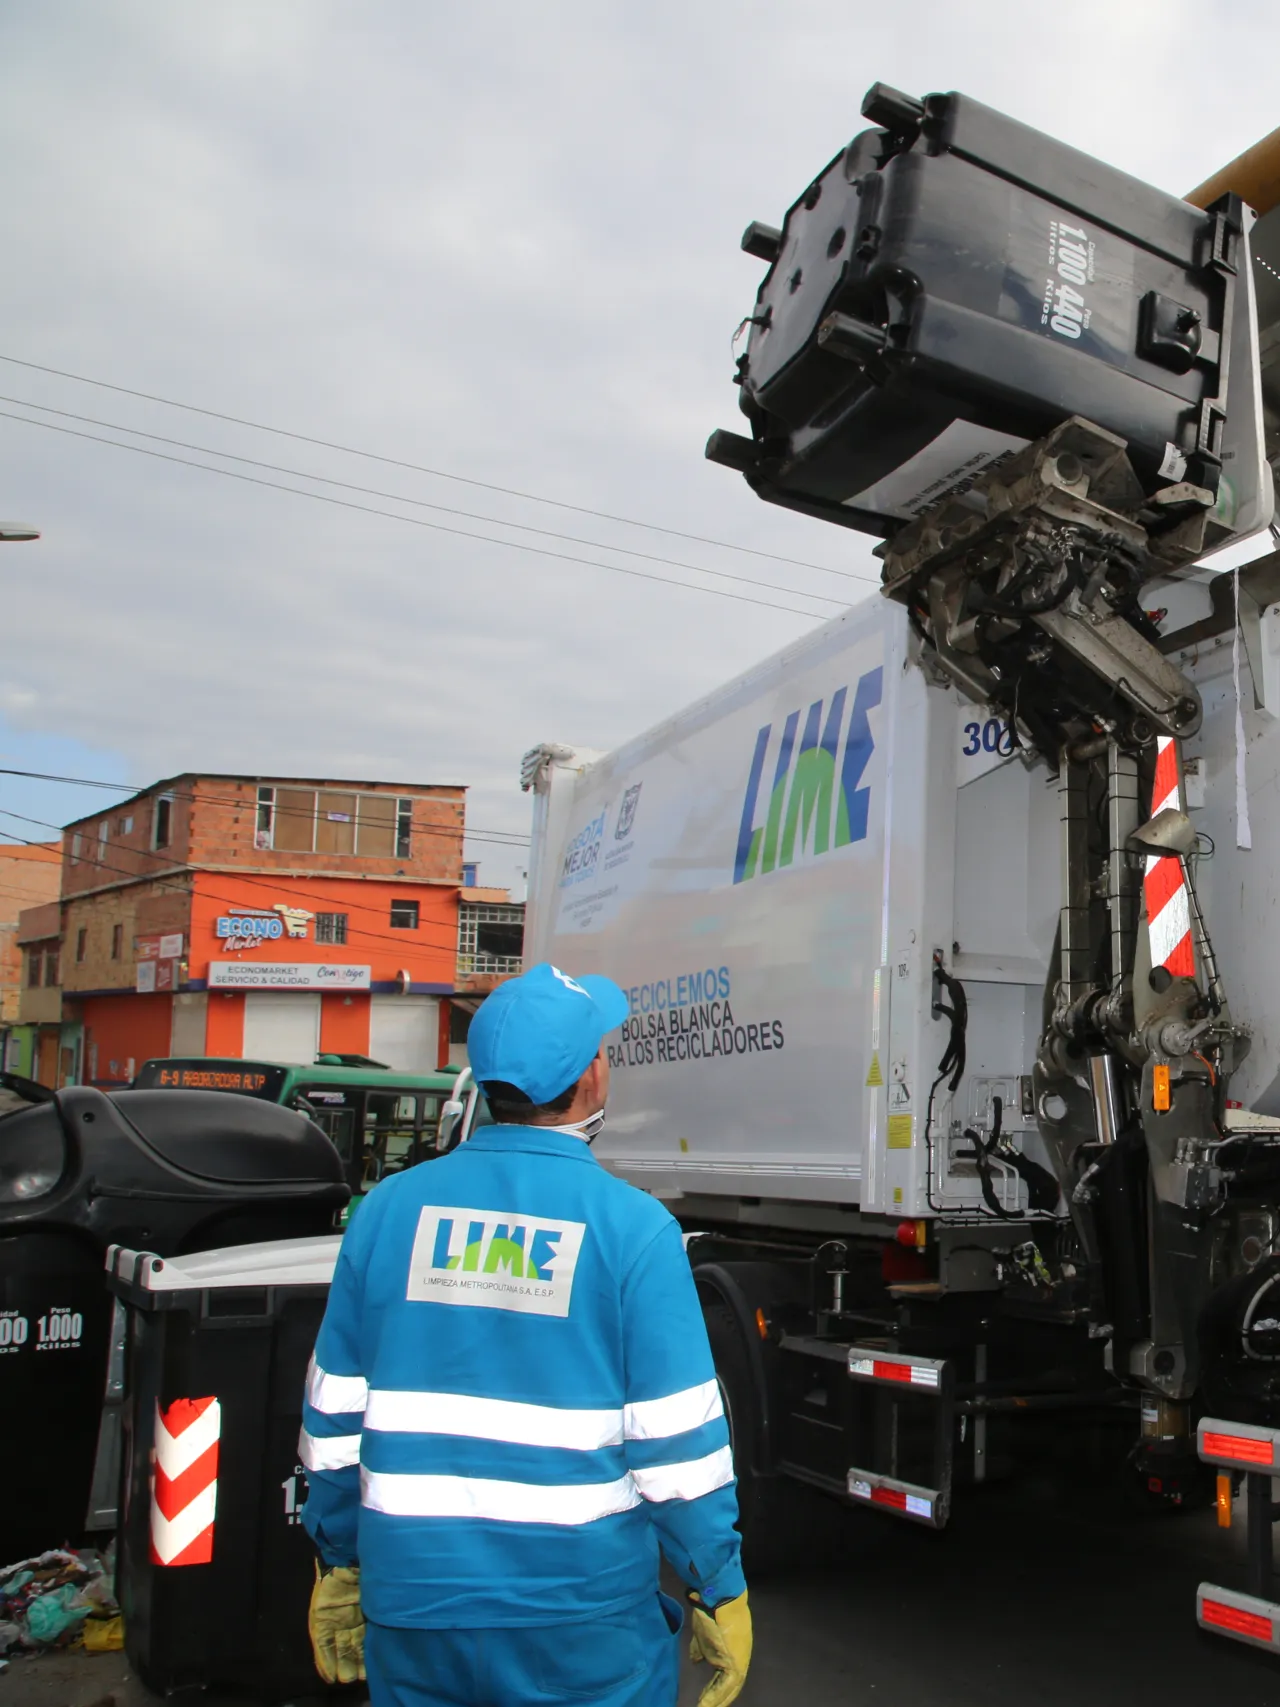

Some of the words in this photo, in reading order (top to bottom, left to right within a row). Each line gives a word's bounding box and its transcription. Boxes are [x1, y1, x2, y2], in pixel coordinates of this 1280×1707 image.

[1048, 221, 1058, 265] litros
[1057, 222, 1088, 286] 1.100
[1041, 278, 1055, 325] Kilos
[1050, 284, 1085, 339] 440
[732, 665, 884, 885] LIME
[561, 841, 600, 877] MEJOR
[216, 916, 283, 939] ECONO
[222, 936, 263, 952] Market
[215, 975, 259, 984] SERVICIO
[270, 976, 310, 985] CALIDAD
[228, 965, 298, 975] ECONOMARKET
[624, 966, 730, 1016] ECICLEMOS
[622, 1012, 667, 1042] BOLSA
[670, 1000, 735, 1035] BLANCA
[608, 1045, 626, 1068] RA
[628, 1041, 654, 1066] LOS
[657, 1019, 785, 1063] RECICLADORES
[431, 1218, 563, 1282] LIME
[423, 1277, 458, 1288] LIMPIEZA
[460, 1279, 518, 1294] METROPOLITANA
[0, 1317, 28, 1346] 00
[37, 1313, 82, 1343] 1.000
[36, 1341, 81, 1351] Kilos
